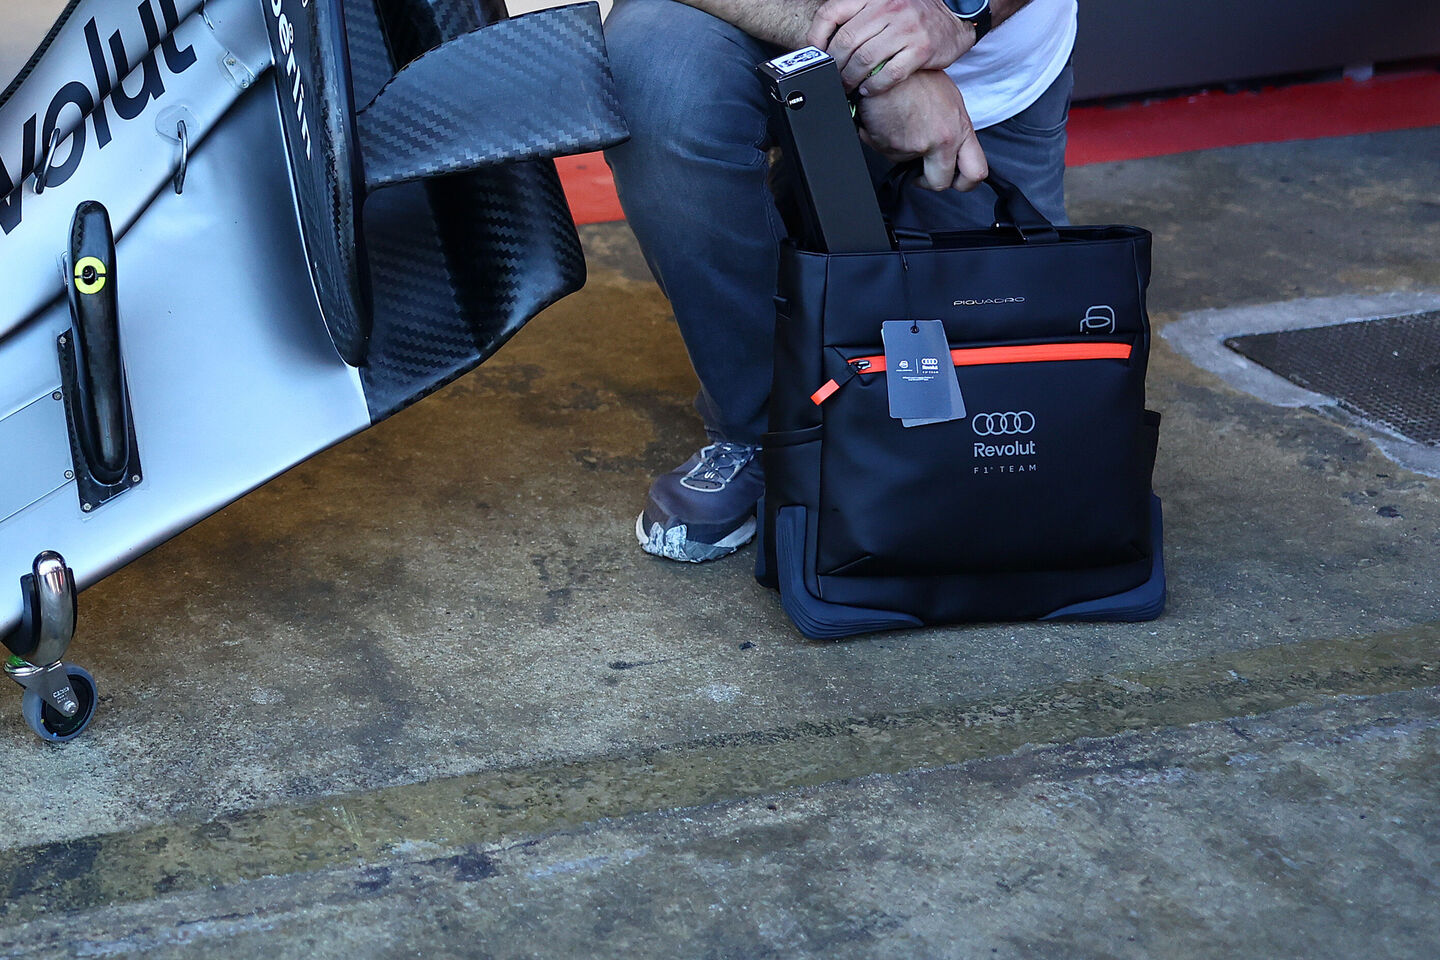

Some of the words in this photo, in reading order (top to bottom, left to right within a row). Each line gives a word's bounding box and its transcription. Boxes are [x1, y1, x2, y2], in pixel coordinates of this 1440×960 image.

[953, 296, 1026, 307] PIQUADRO
[973, 440, 1036, 457] Revolut
[999, 464, 1037, 474] TEAM
